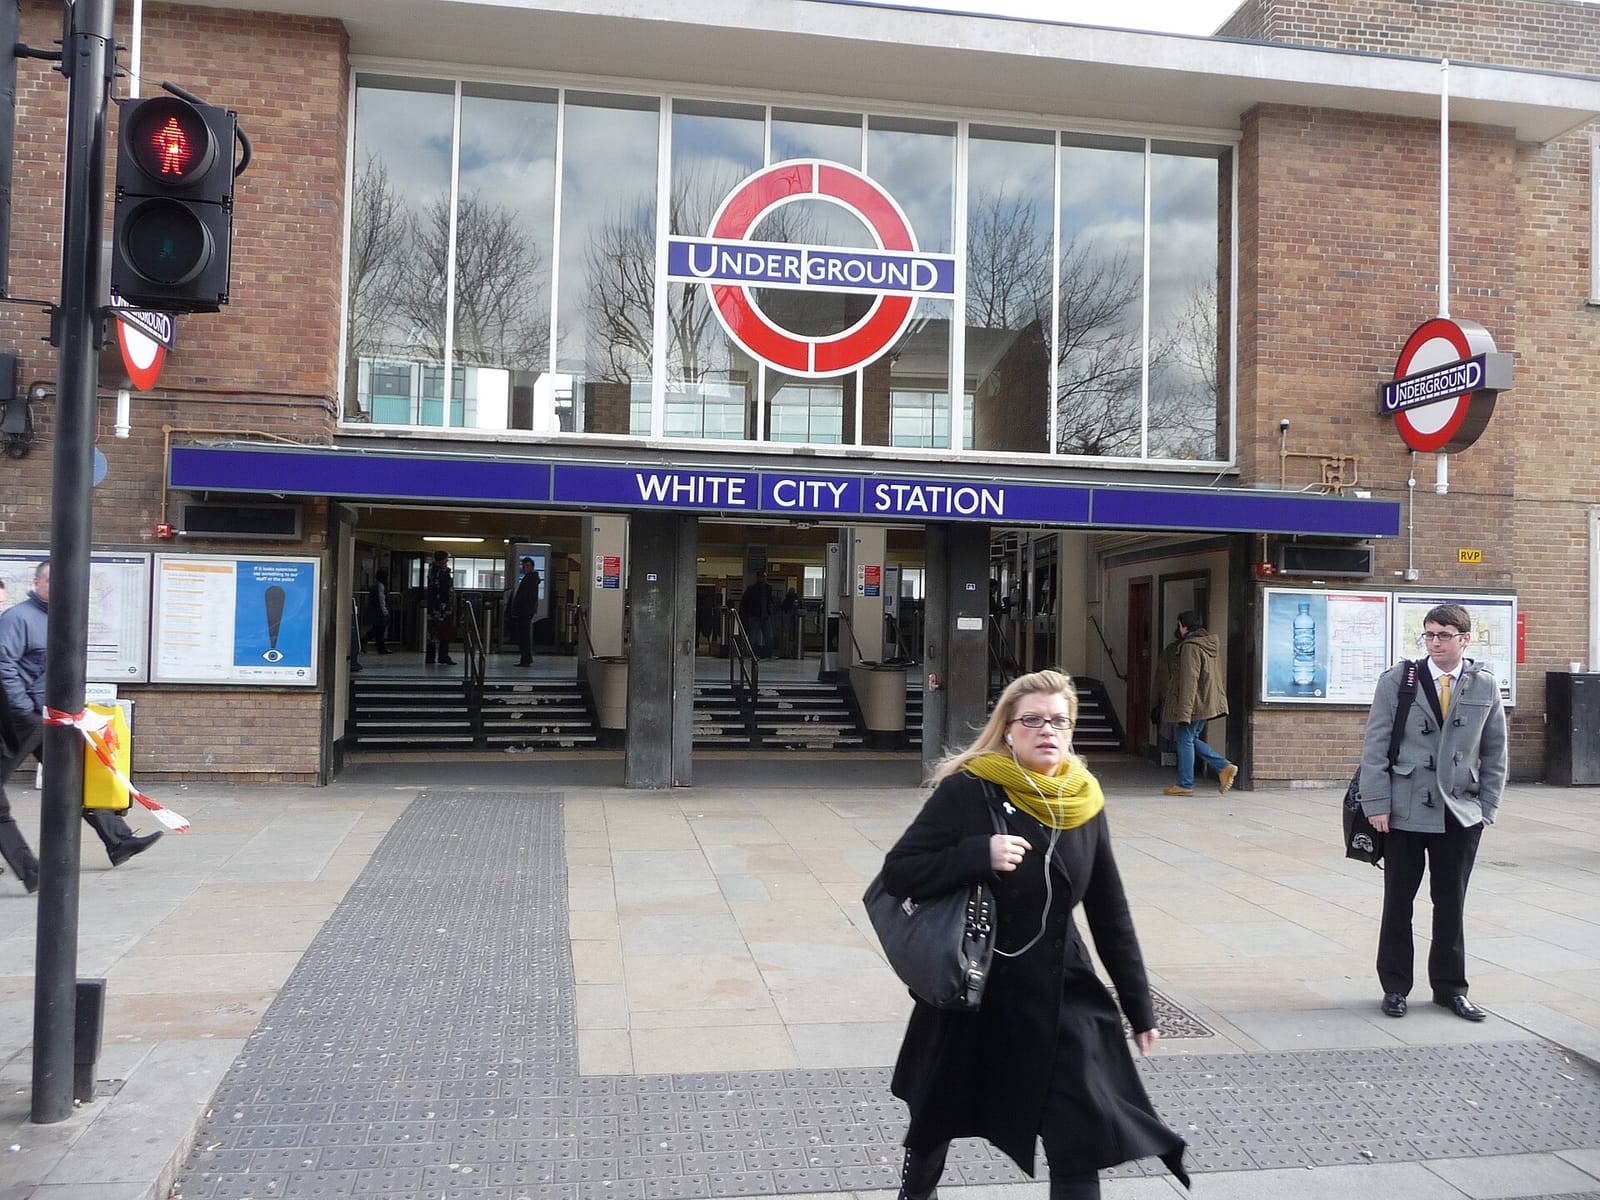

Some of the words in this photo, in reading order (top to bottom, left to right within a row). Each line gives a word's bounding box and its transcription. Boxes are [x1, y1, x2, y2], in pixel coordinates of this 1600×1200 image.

[688, 243, 939, 291] UNDERGROUND
[1386, 361, 1481, 409] UNDERGROUND
[636, 473, 746, 505] WHITE
[773, 479, 848, 509] CITY
[875, 483, 1004, 516] STATION
[1460, 551, 1480, 561] RVP
